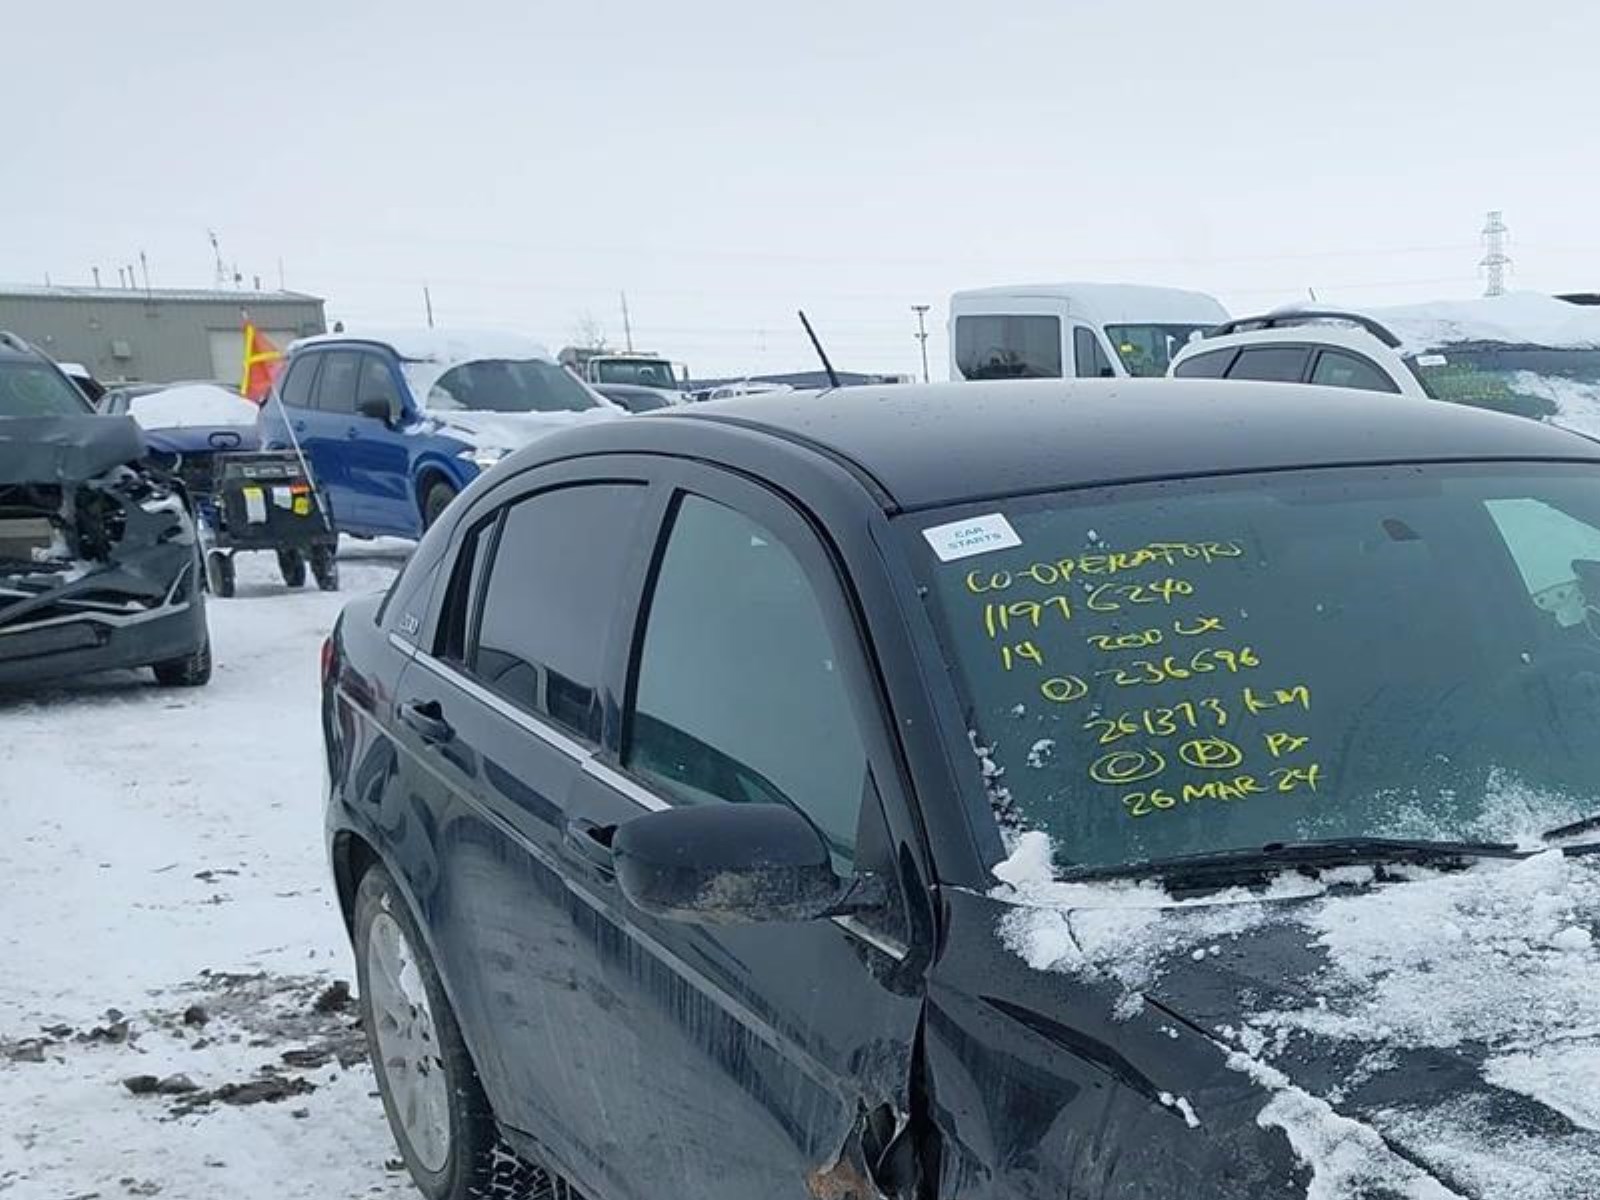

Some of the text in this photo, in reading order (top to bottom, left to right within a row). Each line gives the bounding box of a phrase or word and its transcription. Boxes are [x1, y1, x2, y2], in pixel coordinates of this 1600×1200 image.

[947, 532, 1002, 549] STARTS
[954, 526, 984, 539] CAR
[1182, 775, 1271, 803] MAR
